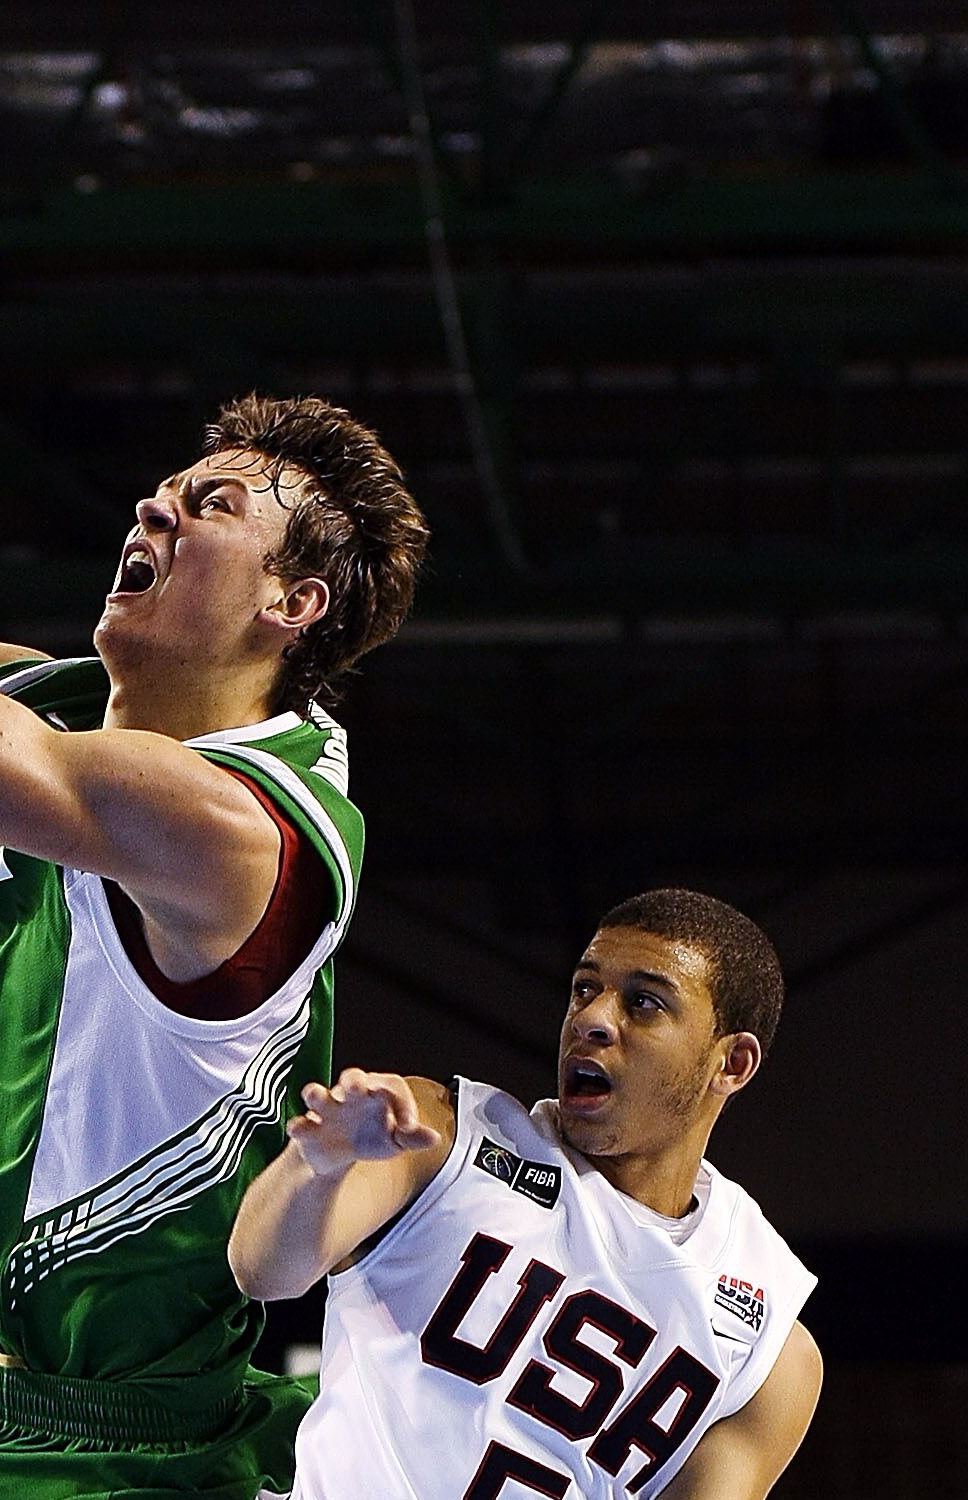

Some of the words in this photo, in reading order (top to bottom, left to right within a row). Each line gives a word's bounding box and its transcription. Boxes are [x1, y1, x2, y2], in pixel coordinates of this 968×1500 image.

[525, 1168, 556, 1188] FIBA
[717, 1274, 763, 1317] USA
[420, 1232, 721, 1495] USA
